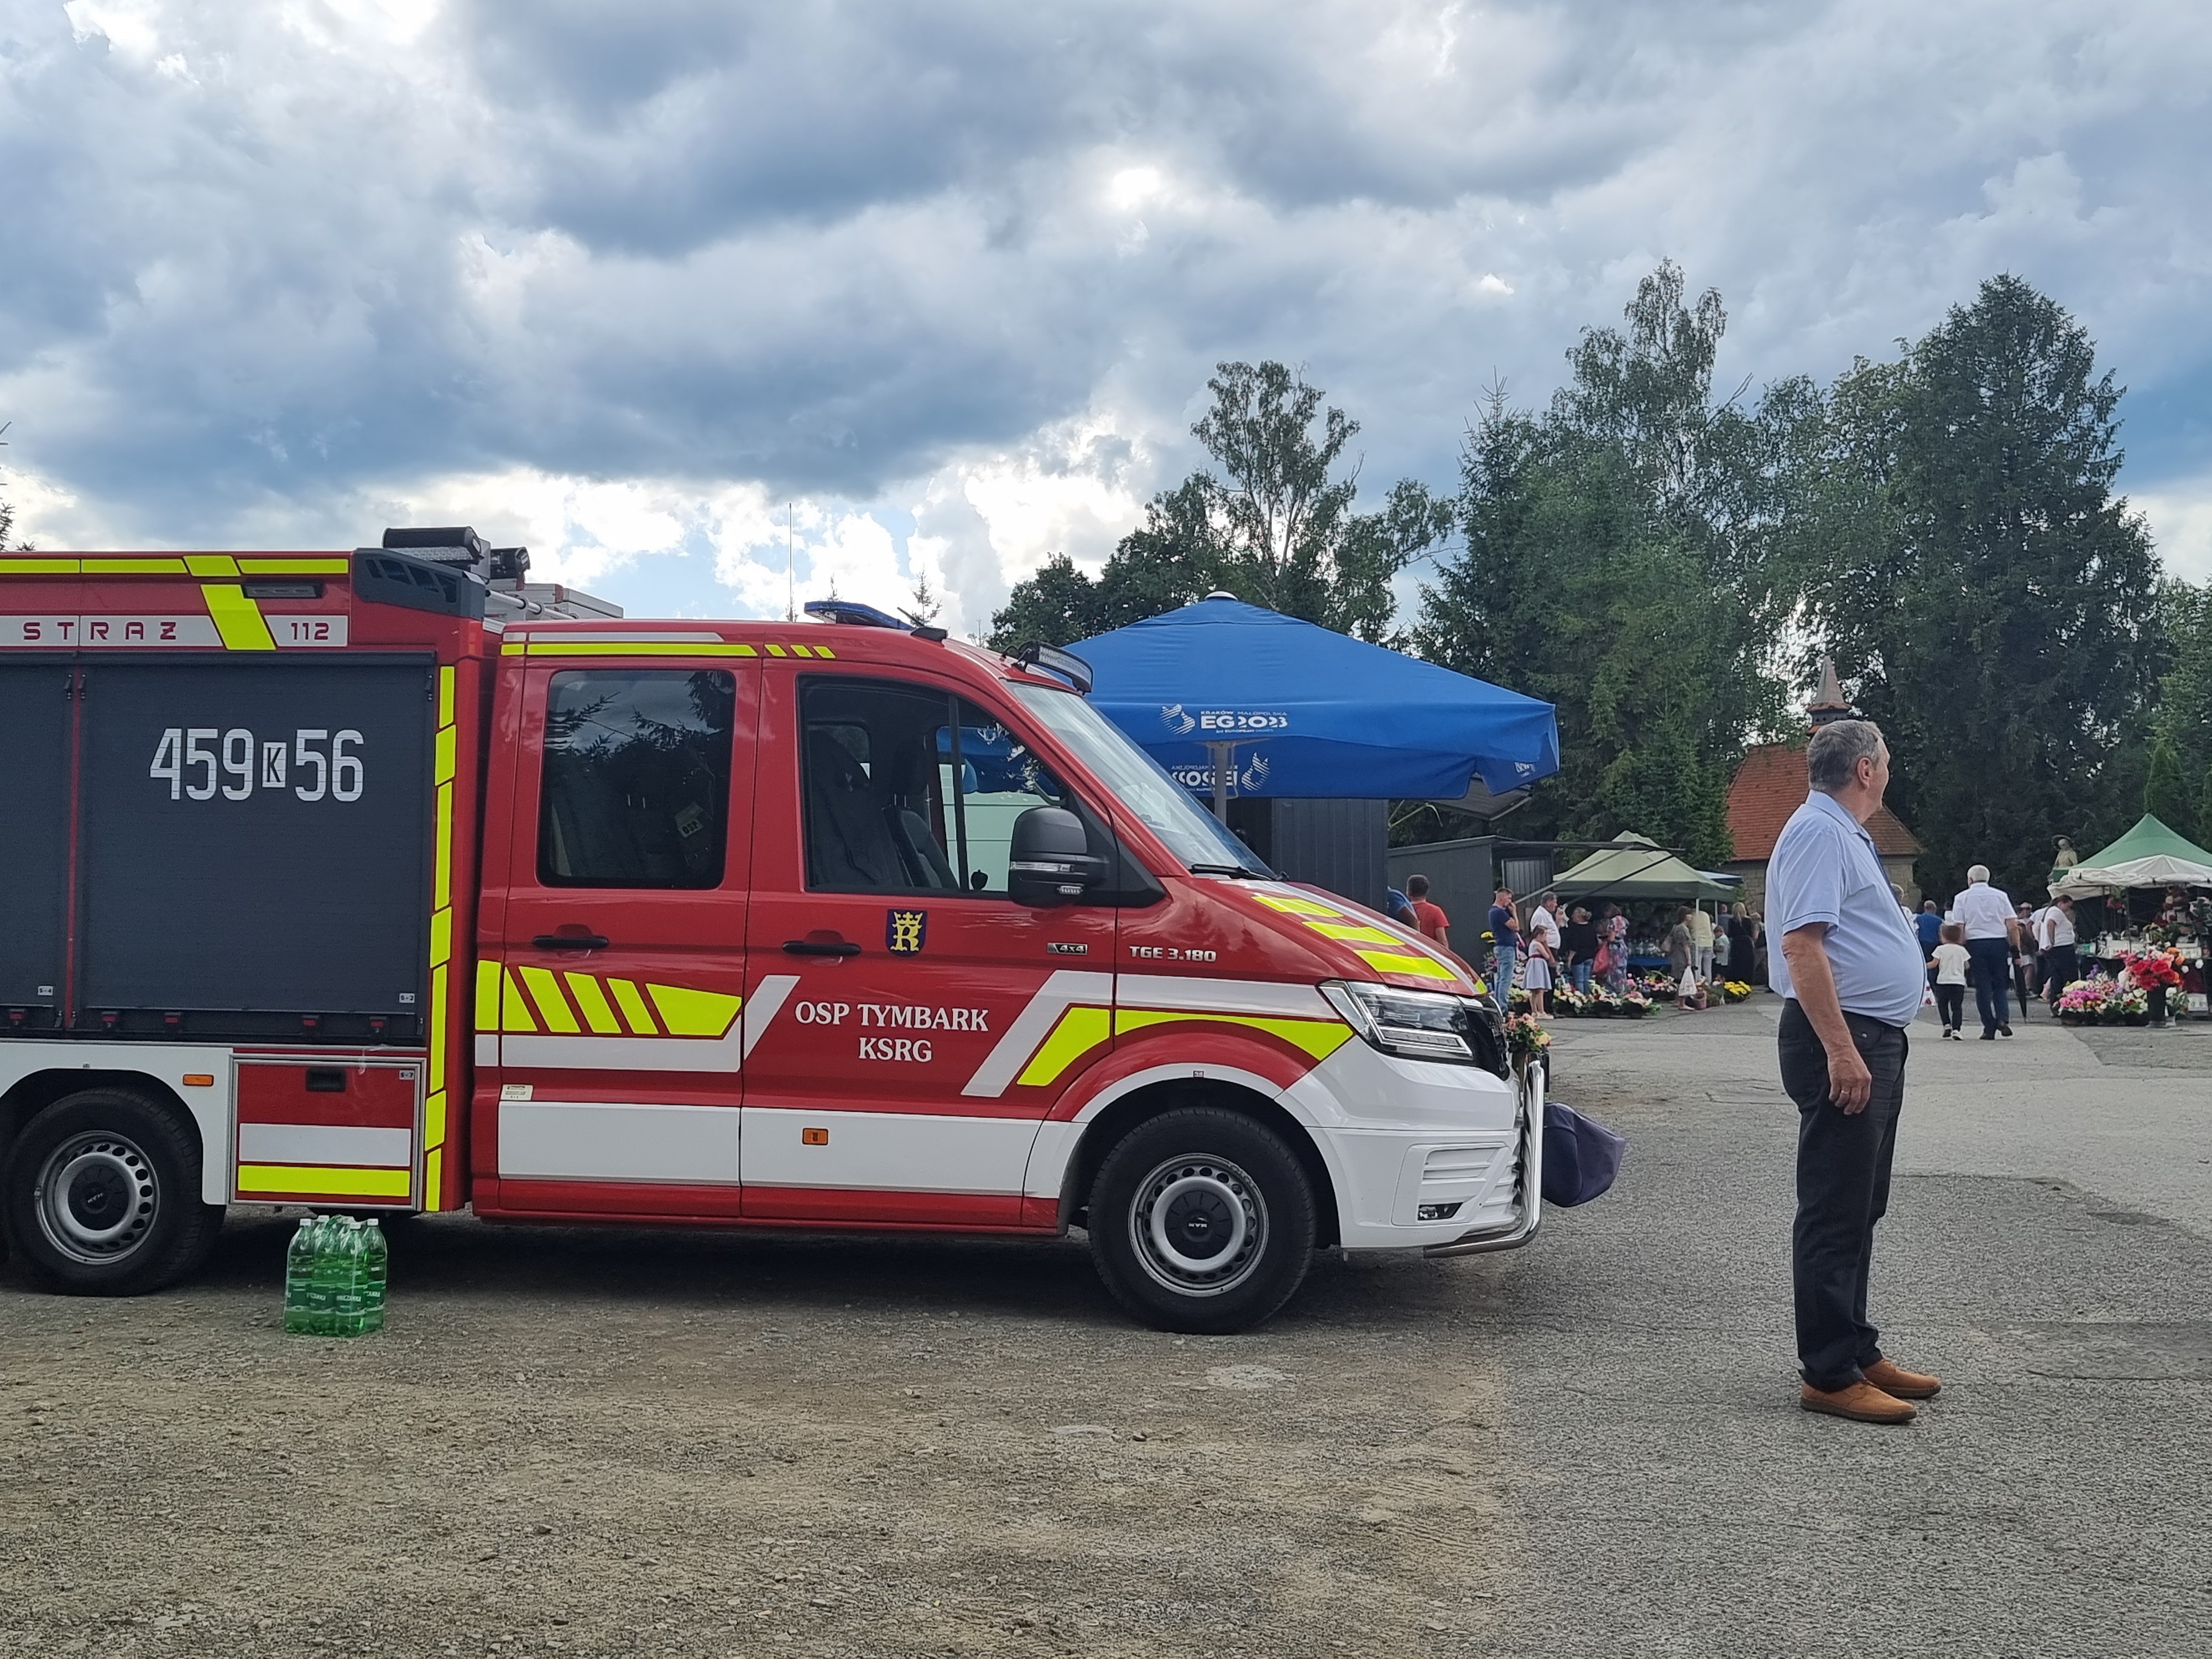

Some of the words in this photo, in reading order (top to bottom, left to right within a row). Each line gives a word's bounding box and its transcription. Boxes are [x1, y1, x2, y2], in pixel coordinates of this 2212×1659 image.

[290, 622, 330, 640] 112
[1058, 945, 1085, 953] 4x4
[1129, 946, 1163, 959] TGE
[1167, 948, 1217, 962] 3.180
[795, 1001, 850, 1025] OSP
[857, 1004, 989, 1032] TYMBARK
[858, 1037, 932, 1062] KSRG
